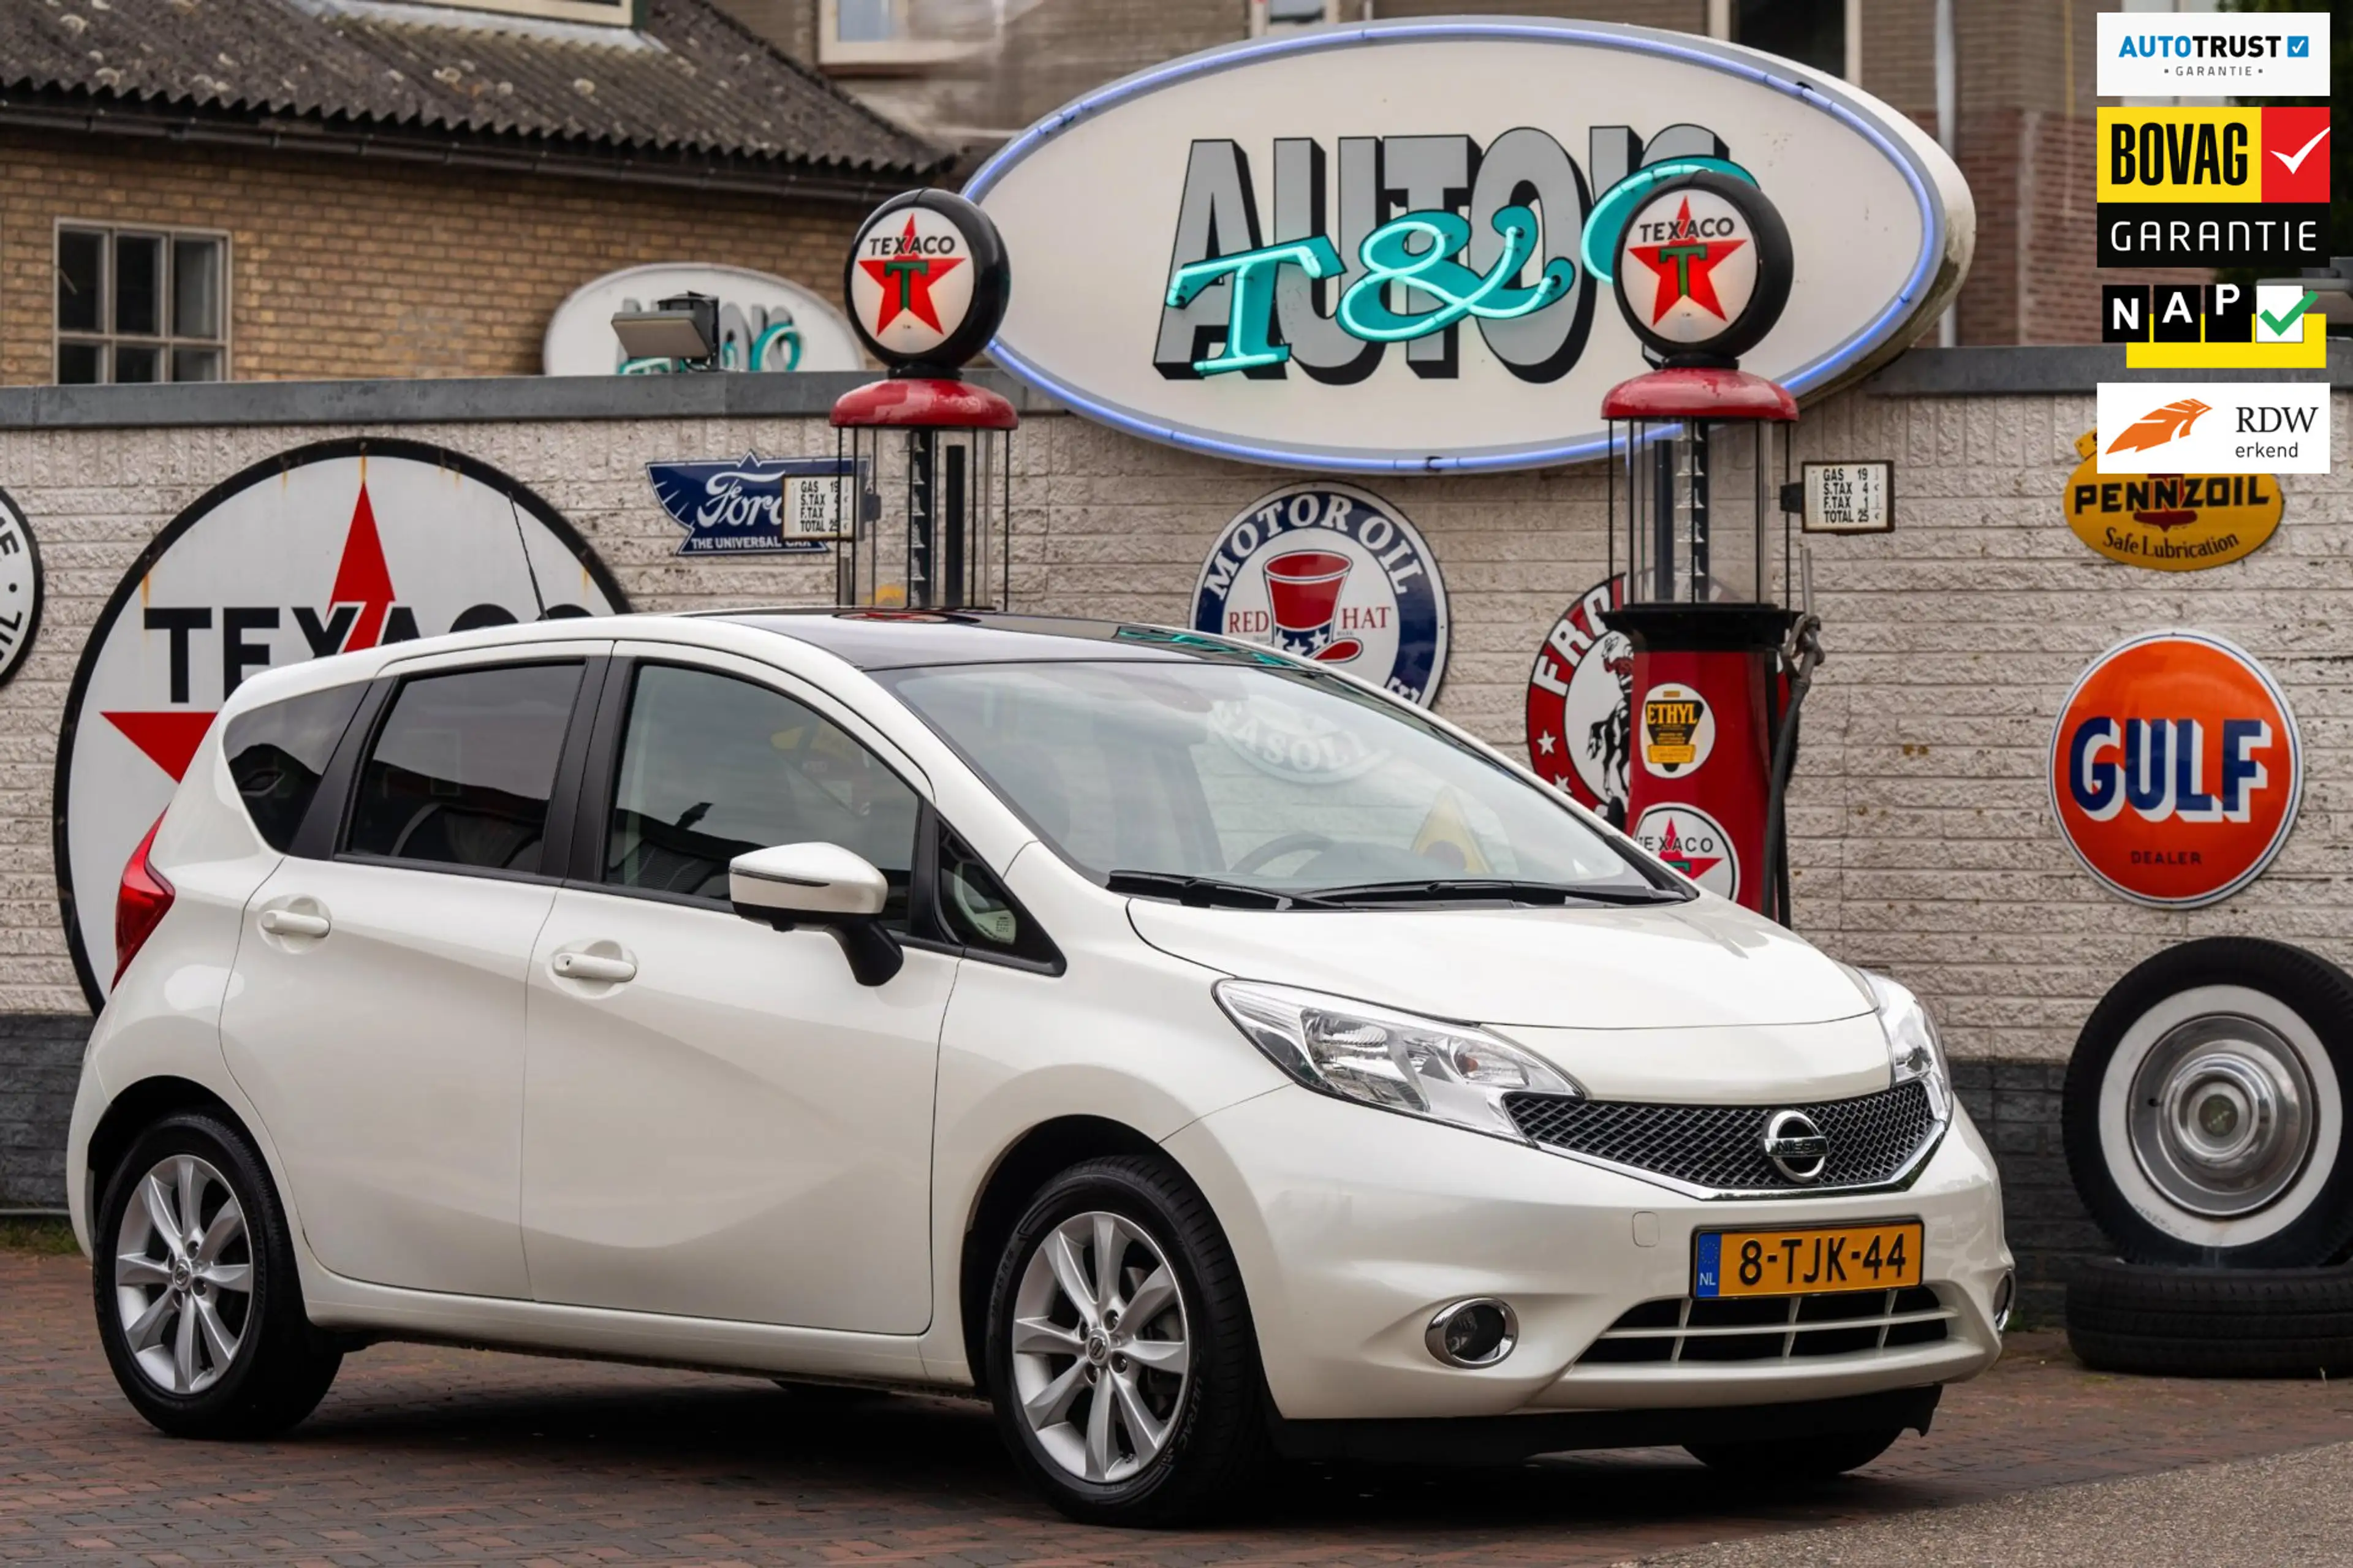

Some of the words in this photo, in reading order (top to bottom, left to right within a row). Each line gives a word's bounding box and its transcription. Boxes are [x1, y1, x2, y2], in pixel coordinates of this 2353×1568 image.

[1640, 218, 1734, 242] TEXACO
[870, 236, 955, 256] TEXACO
[1153, 124, 1729, 385] AUTO'
[1822, 468, 1844, 481] GAS
[1857, 467, 1868, 481] 19
[800, 480, 819, 493] GAS
[1823, 482, 1853, 495] S.TAX
[800, 493, 825, 506] S.TAX
[1823, 496, 1852, 509] F.TAX
[2074, 475, 2270, 515] PENNZOIL
[800, 507, 824, 519] F.TAX
[1824, 510, 1855, 524] TOTAL
[800, 520, 826, 532] TOTAL
[691, 537, 714, 550] THE
[714, 536, 782, 549] UNIVERSAL
[1203, 494, 1354, 601] MOTOR
[1358, 516, 1424, 594] OIL
[2103, 526, 2139, 555] Safe
[2143, 533, 2240, 559] Lubrication
[1228, 610, 1270, 634] RED
[1341, 607, 1392, 630] HAT
[1646, 703, 1698, 725] ETHYL
[2069, 716, 2272, 823] GULF
[1637, 836, 1714, 853] EXACO
[2130, 851, 2202, 865] DEALER
[1739, 1233, 1906, 1286] 8-TJK-44
[1699, 1272, 1716, 1287] NL
